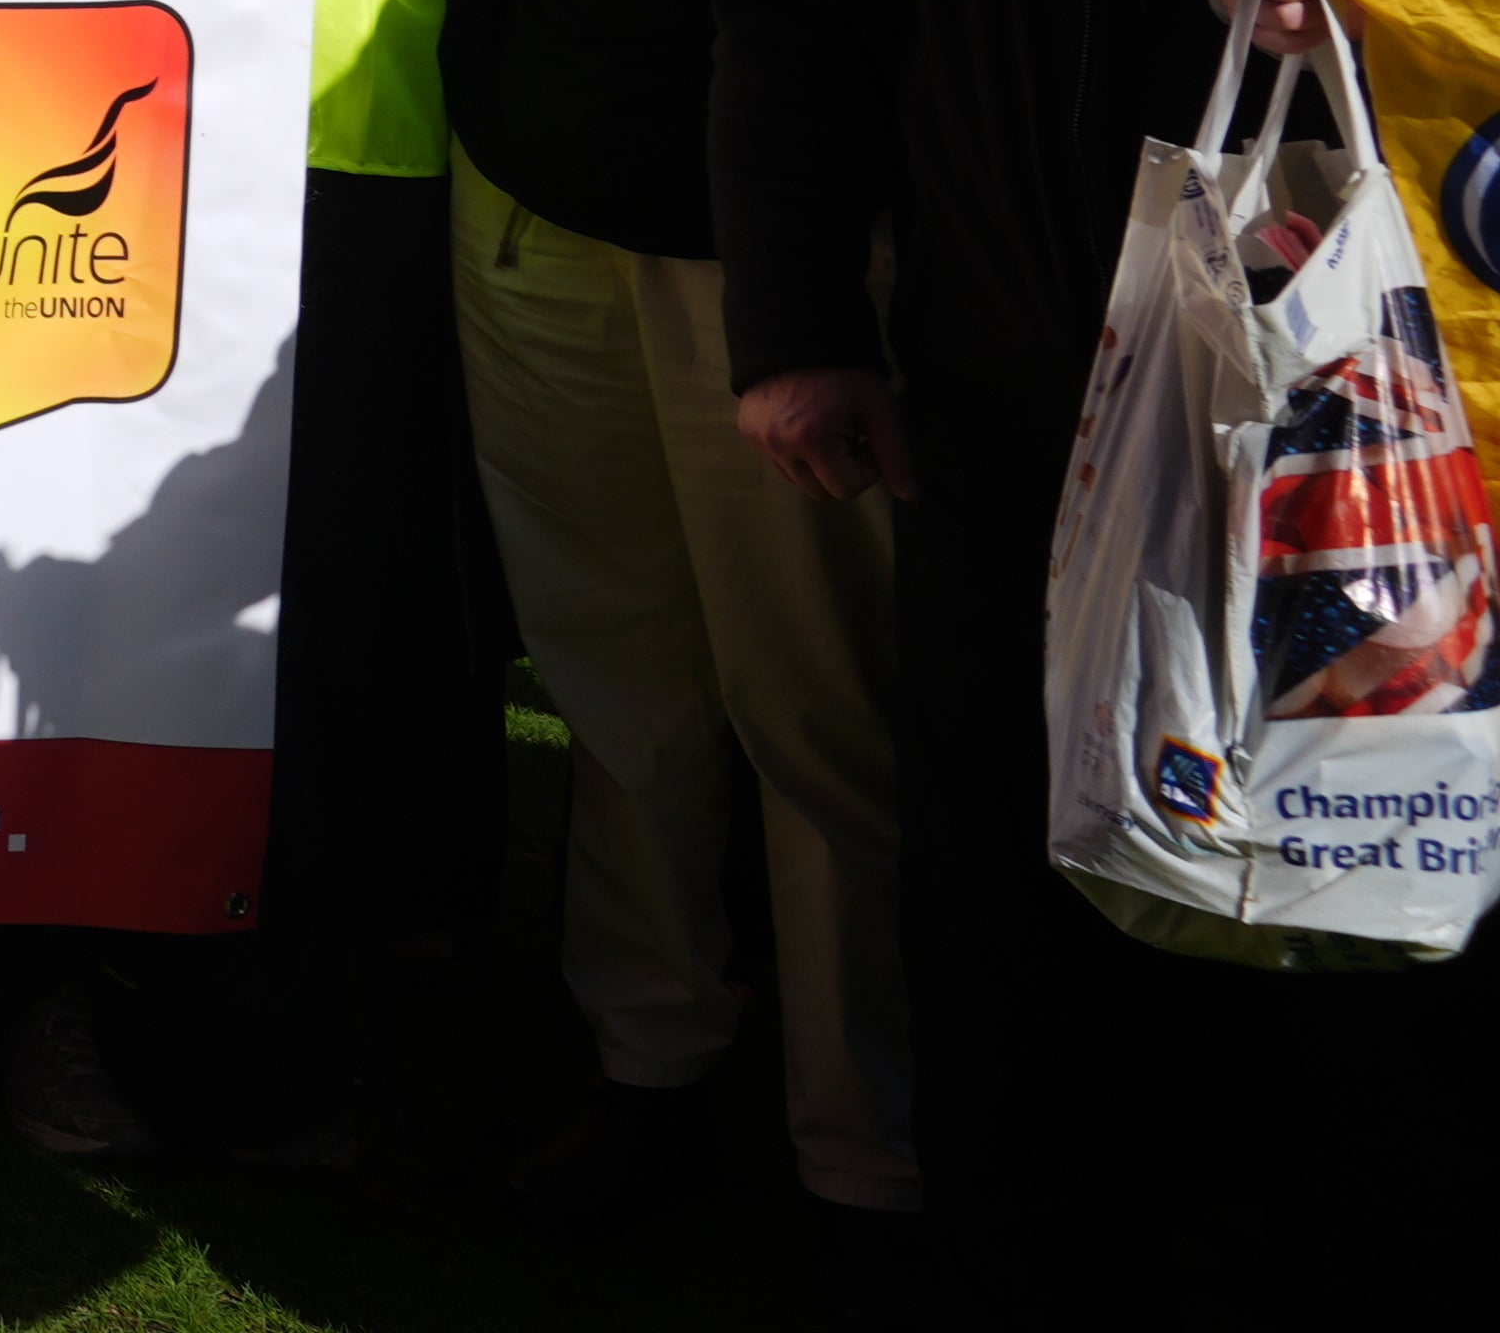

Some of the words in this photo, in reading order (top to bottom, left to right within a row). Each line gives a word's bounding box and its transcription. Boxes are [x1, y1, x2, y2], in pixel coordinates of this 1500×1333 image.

[3, 295, 126, 320] theUNION
[1276, 781, 1478, 826] Champio
[1280, 836, 1403, 869] Great
